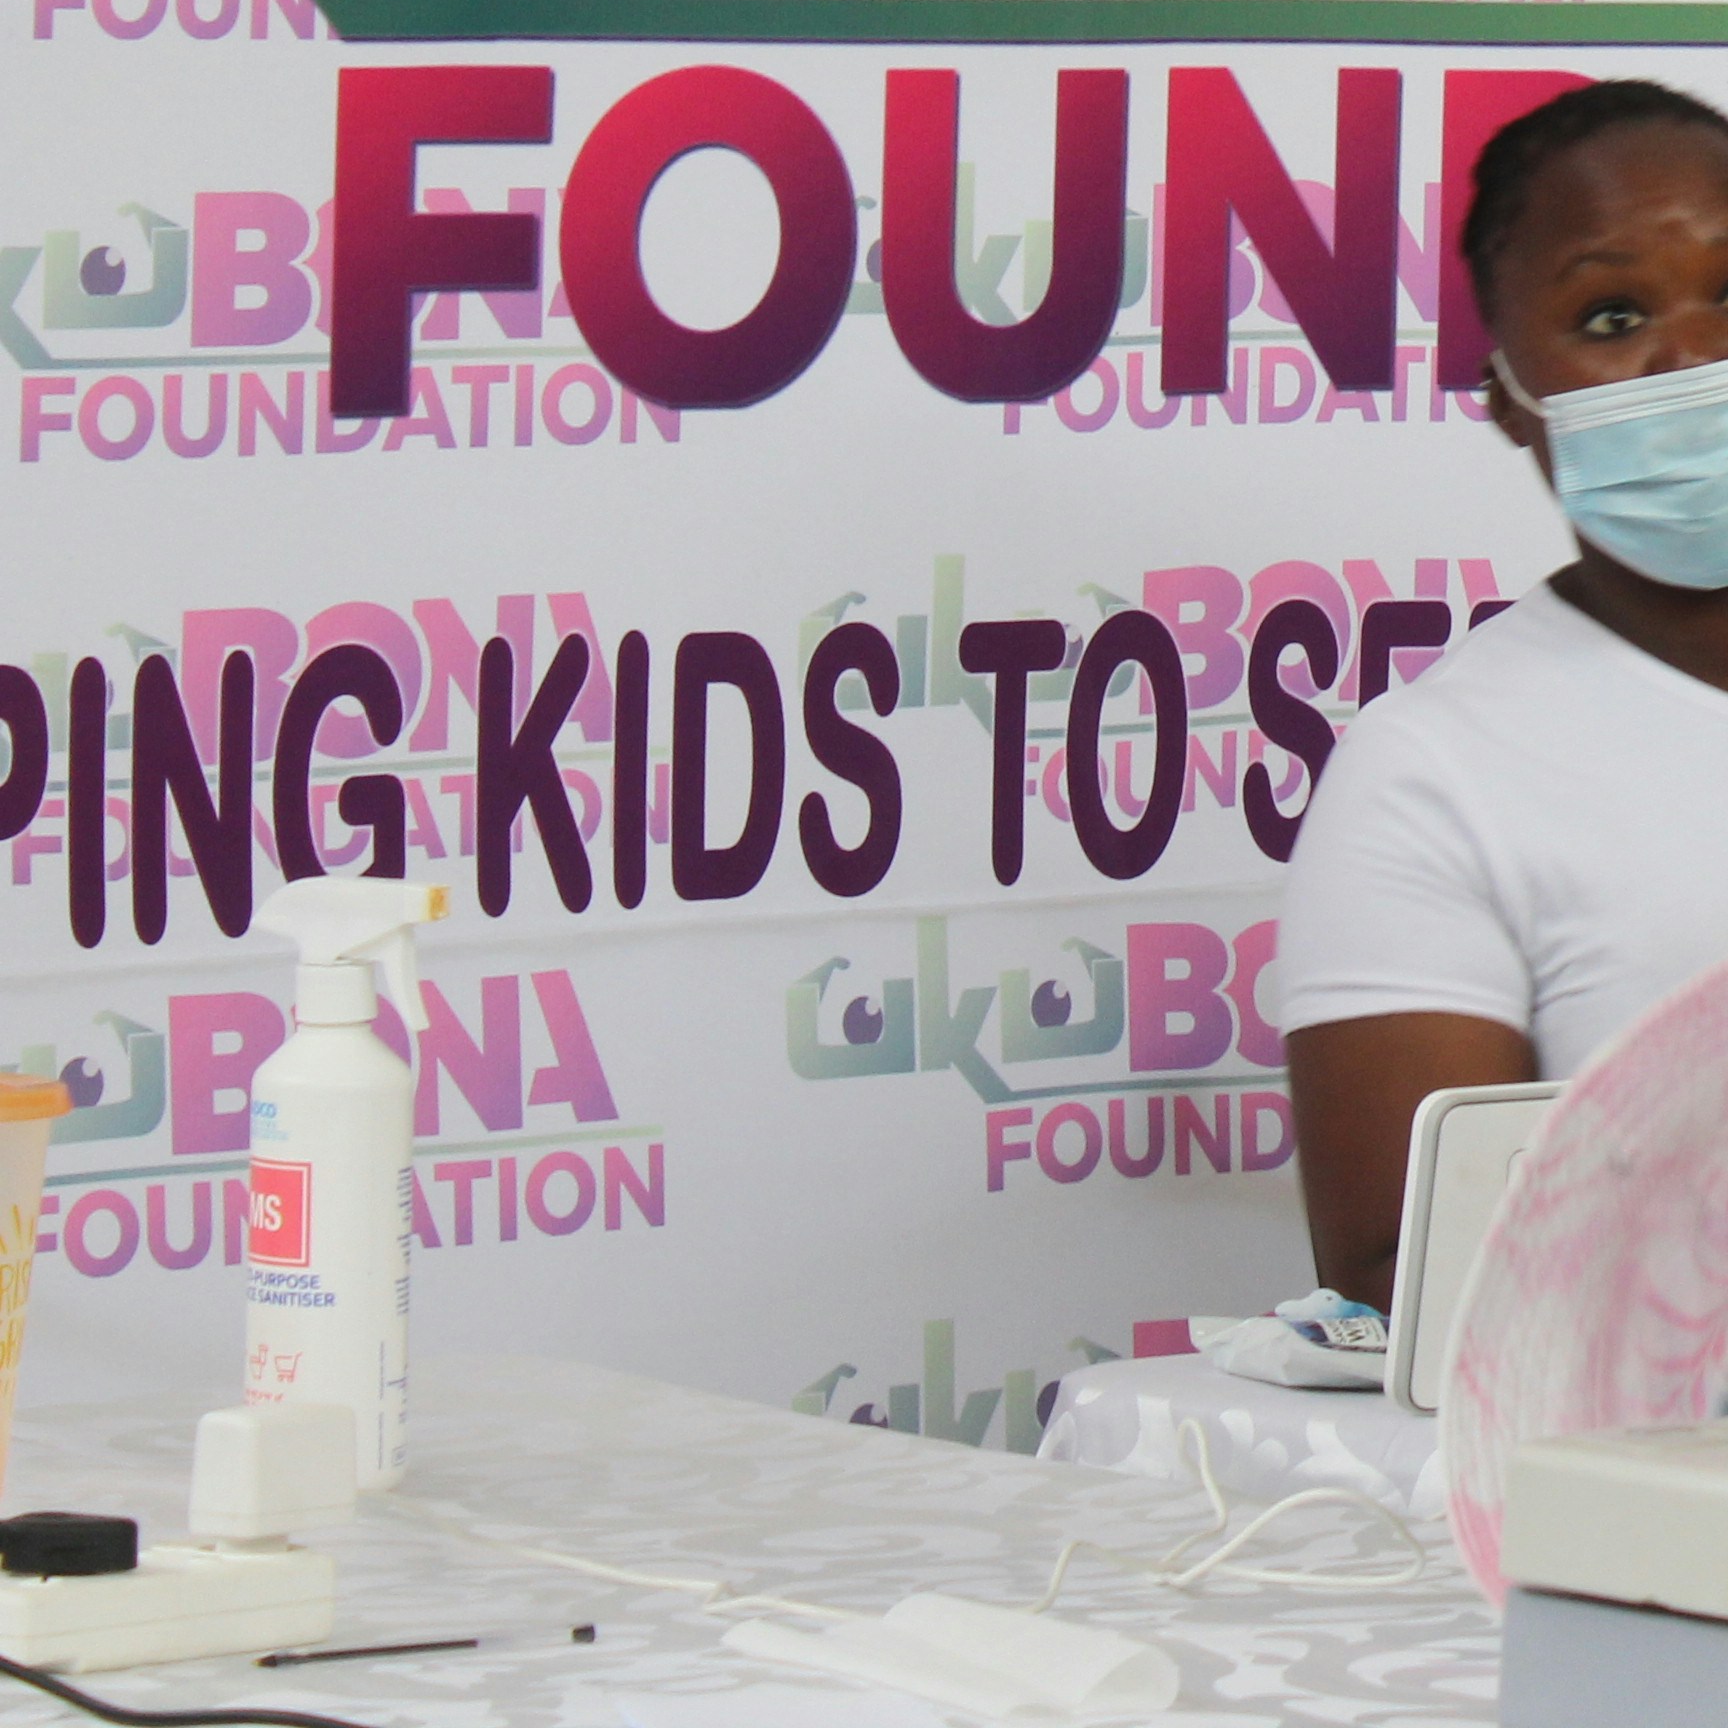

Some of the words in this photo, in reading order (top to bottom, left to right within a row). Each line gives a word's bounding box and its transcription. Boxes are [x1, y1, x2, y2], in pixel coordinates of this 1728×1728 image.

[476, 622, 901, 919] KIDS
[959, 610, 1187, 887] TO
[259, 1288, 337, 1308] SANITISER
